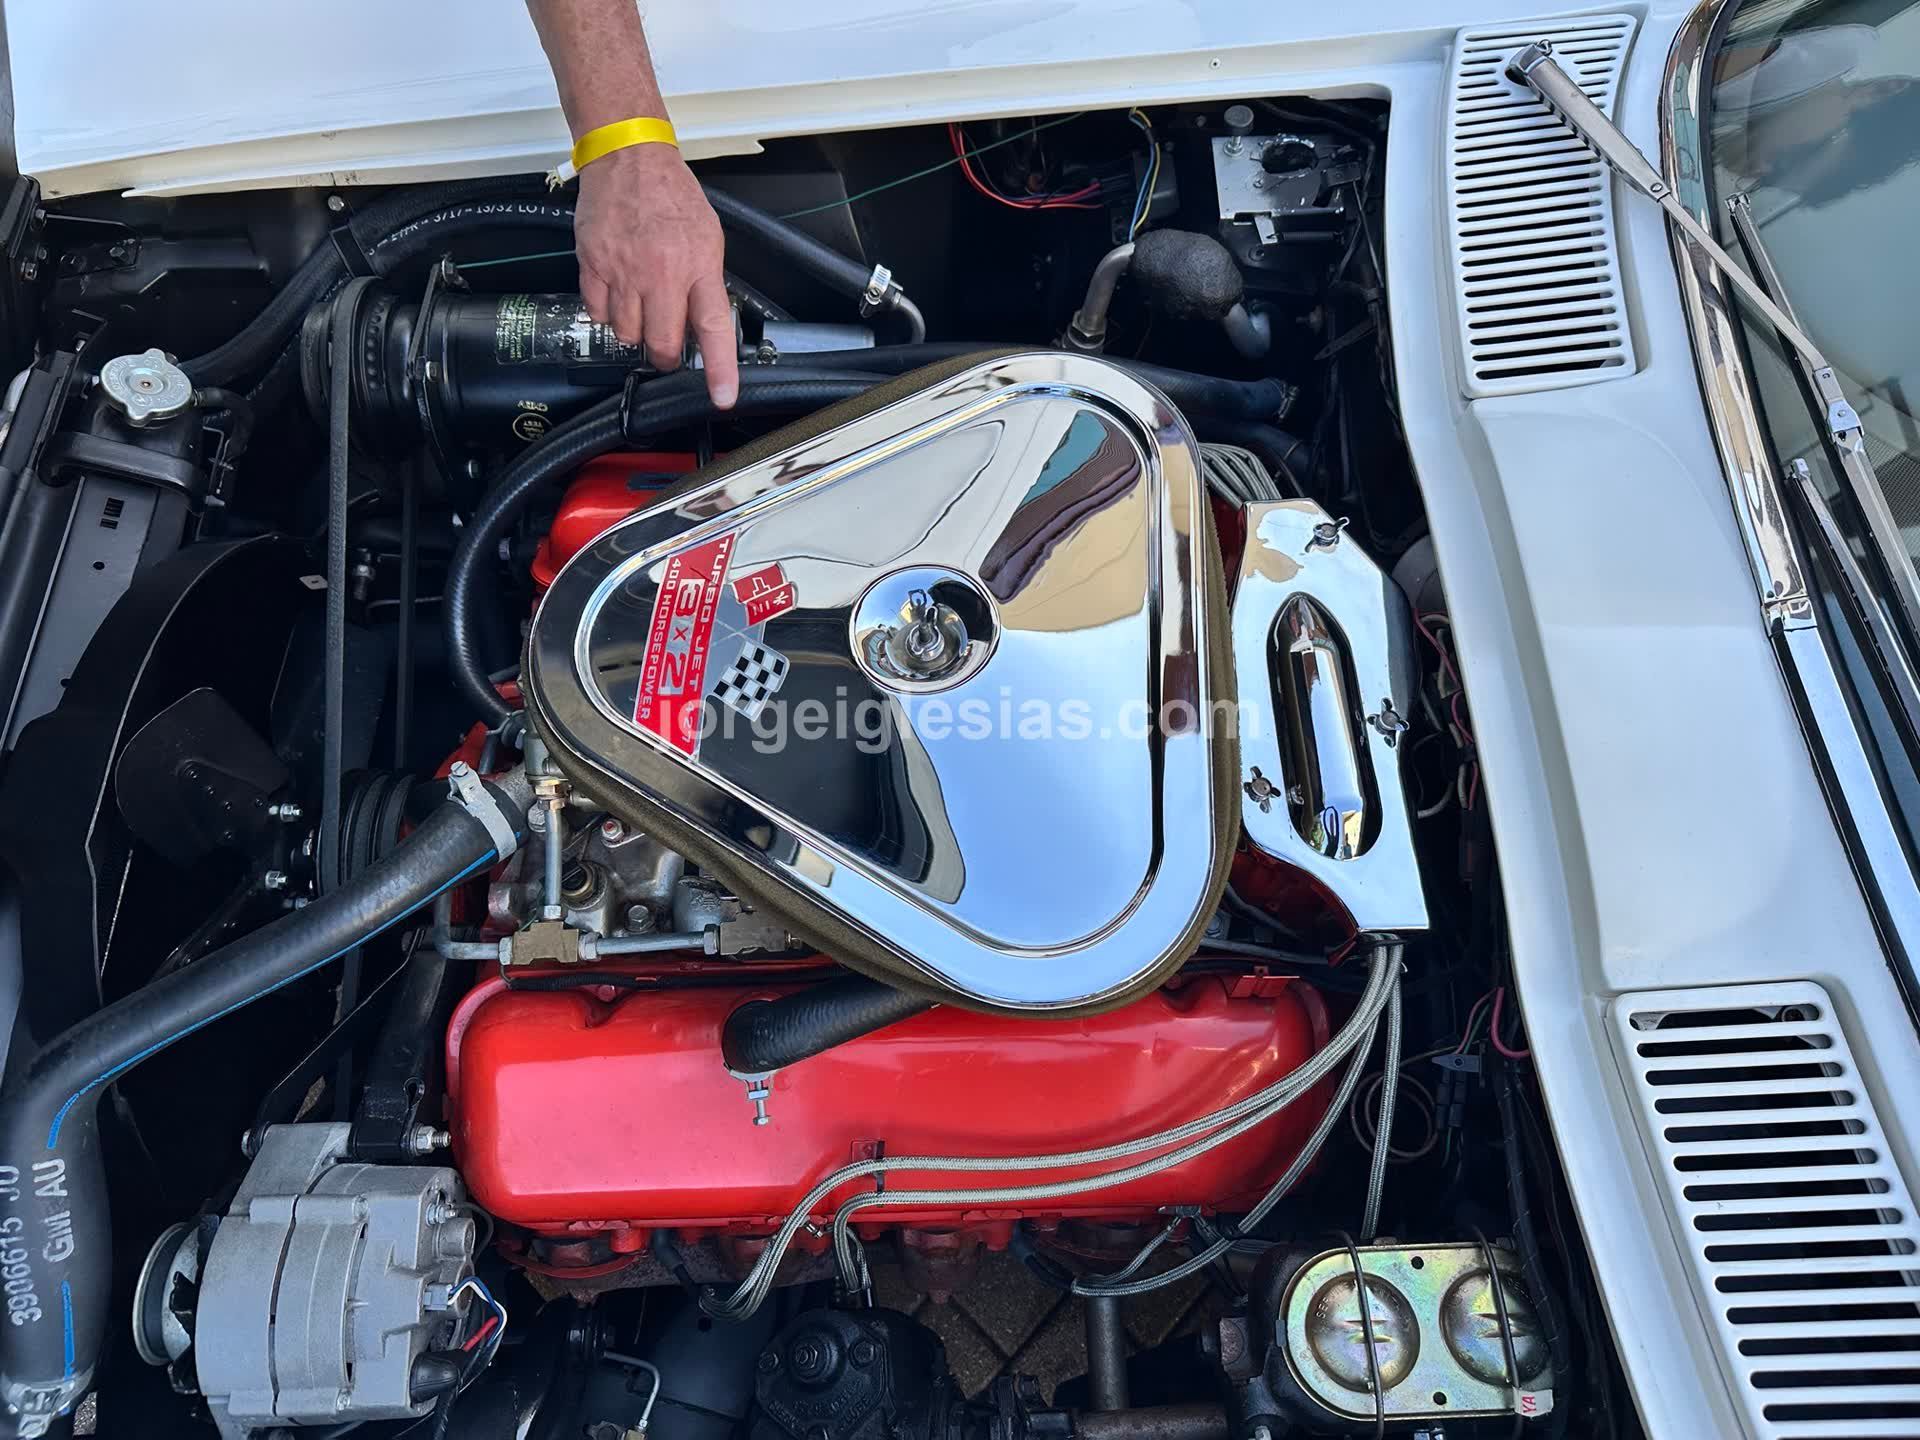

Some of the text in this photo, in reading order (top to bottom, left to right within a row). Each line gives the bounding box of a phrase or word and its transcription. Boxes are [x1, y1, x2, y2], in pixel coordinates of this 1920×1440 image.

[665, 558, 682, 590] 400
[689, 538, 729, 692] TURBO-JET
[641, 594, 673, 720] HORSEPOWER
[32, 1159, 68, 1196] AU
[0, 1217, 42, 1325] 3906615
